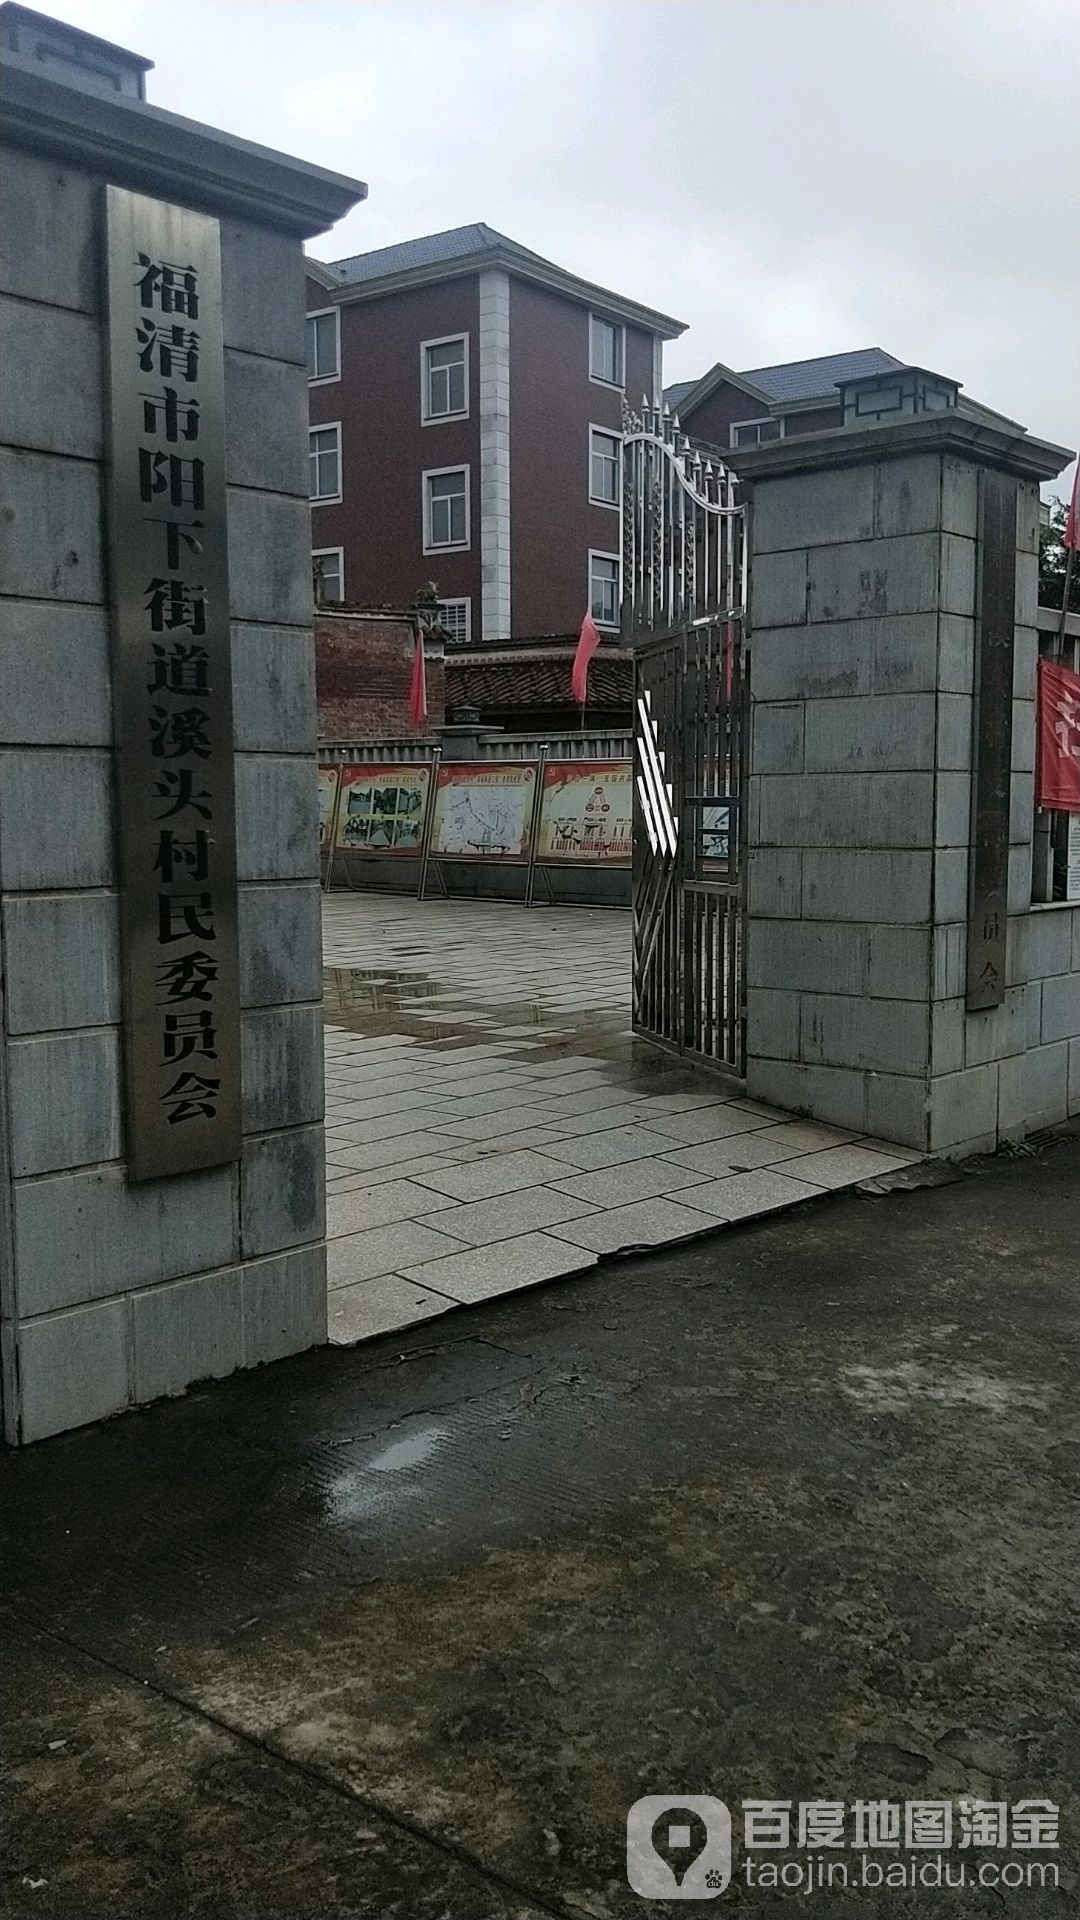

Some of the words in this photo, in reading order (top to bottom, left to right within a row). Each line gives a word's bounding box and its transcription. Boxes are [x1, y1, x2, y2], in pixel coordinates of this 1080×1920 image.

[132, 250, 221, 1125] 福清市阳下街道溪头村民委员会
